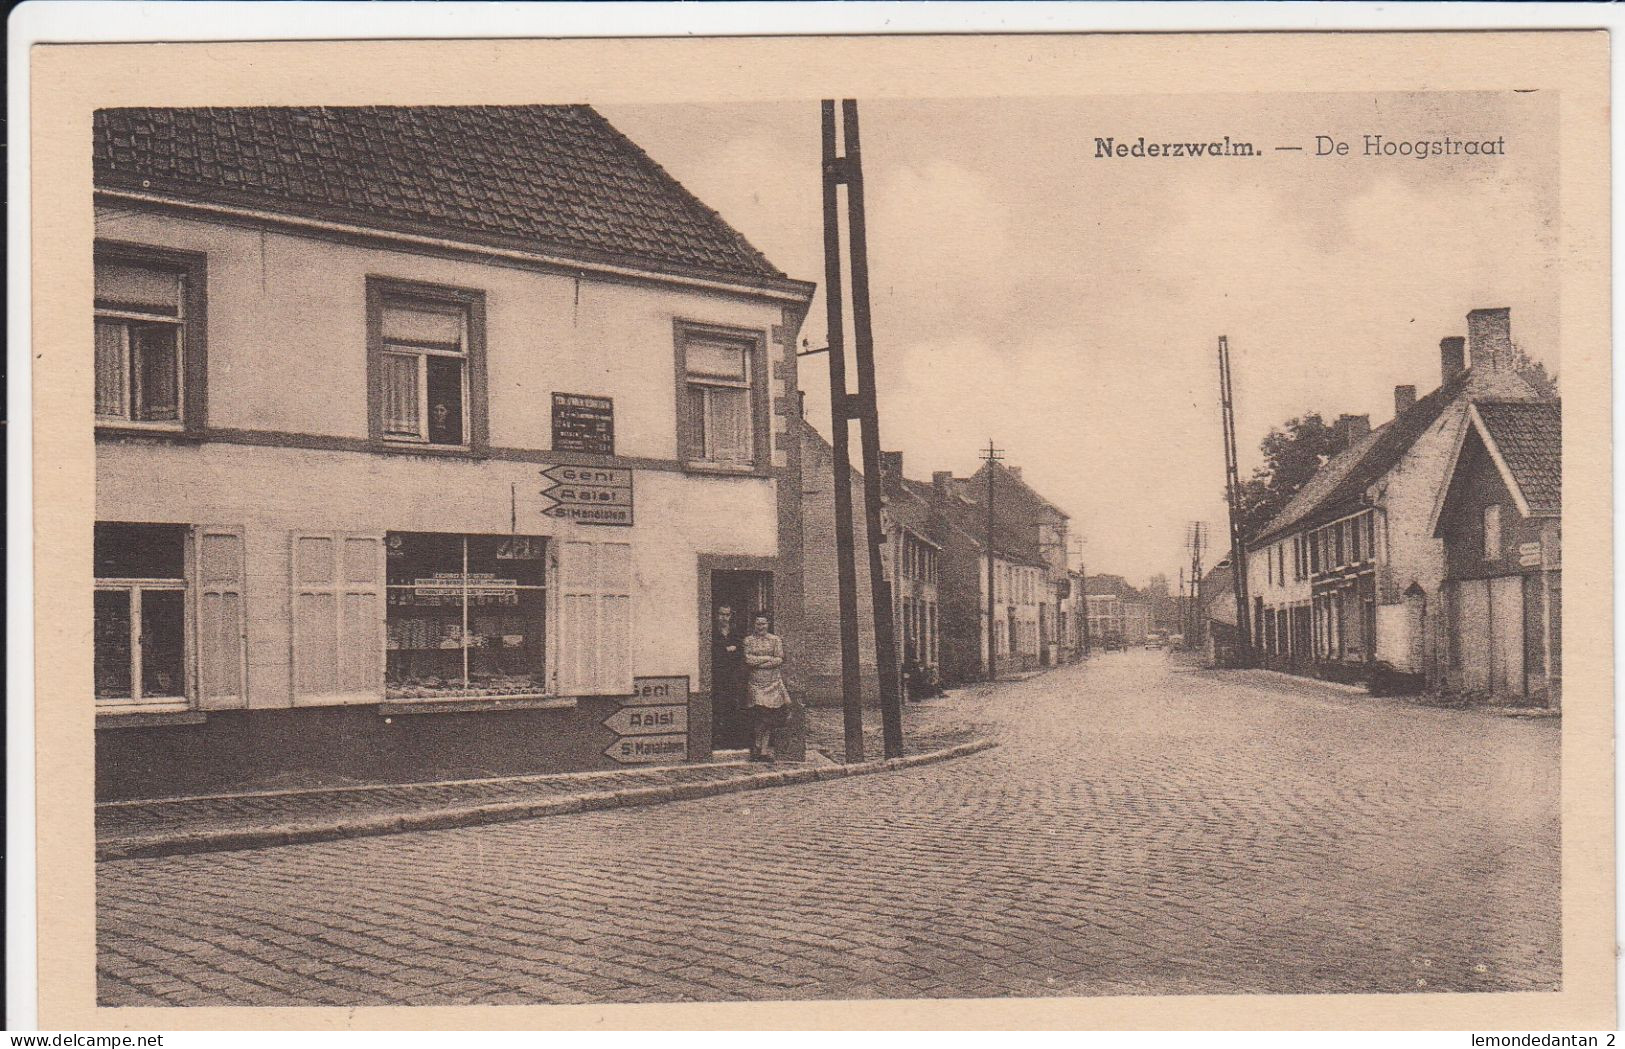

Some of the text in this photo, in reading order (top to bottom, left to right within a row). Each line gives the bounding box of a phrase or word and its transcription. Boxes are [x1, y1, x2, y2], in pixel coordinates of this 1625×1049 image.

[563, 469, 613, 481] Gent
[561, 489, 616, 501] Aalst
[630, 711, 674, 727] Aalst
